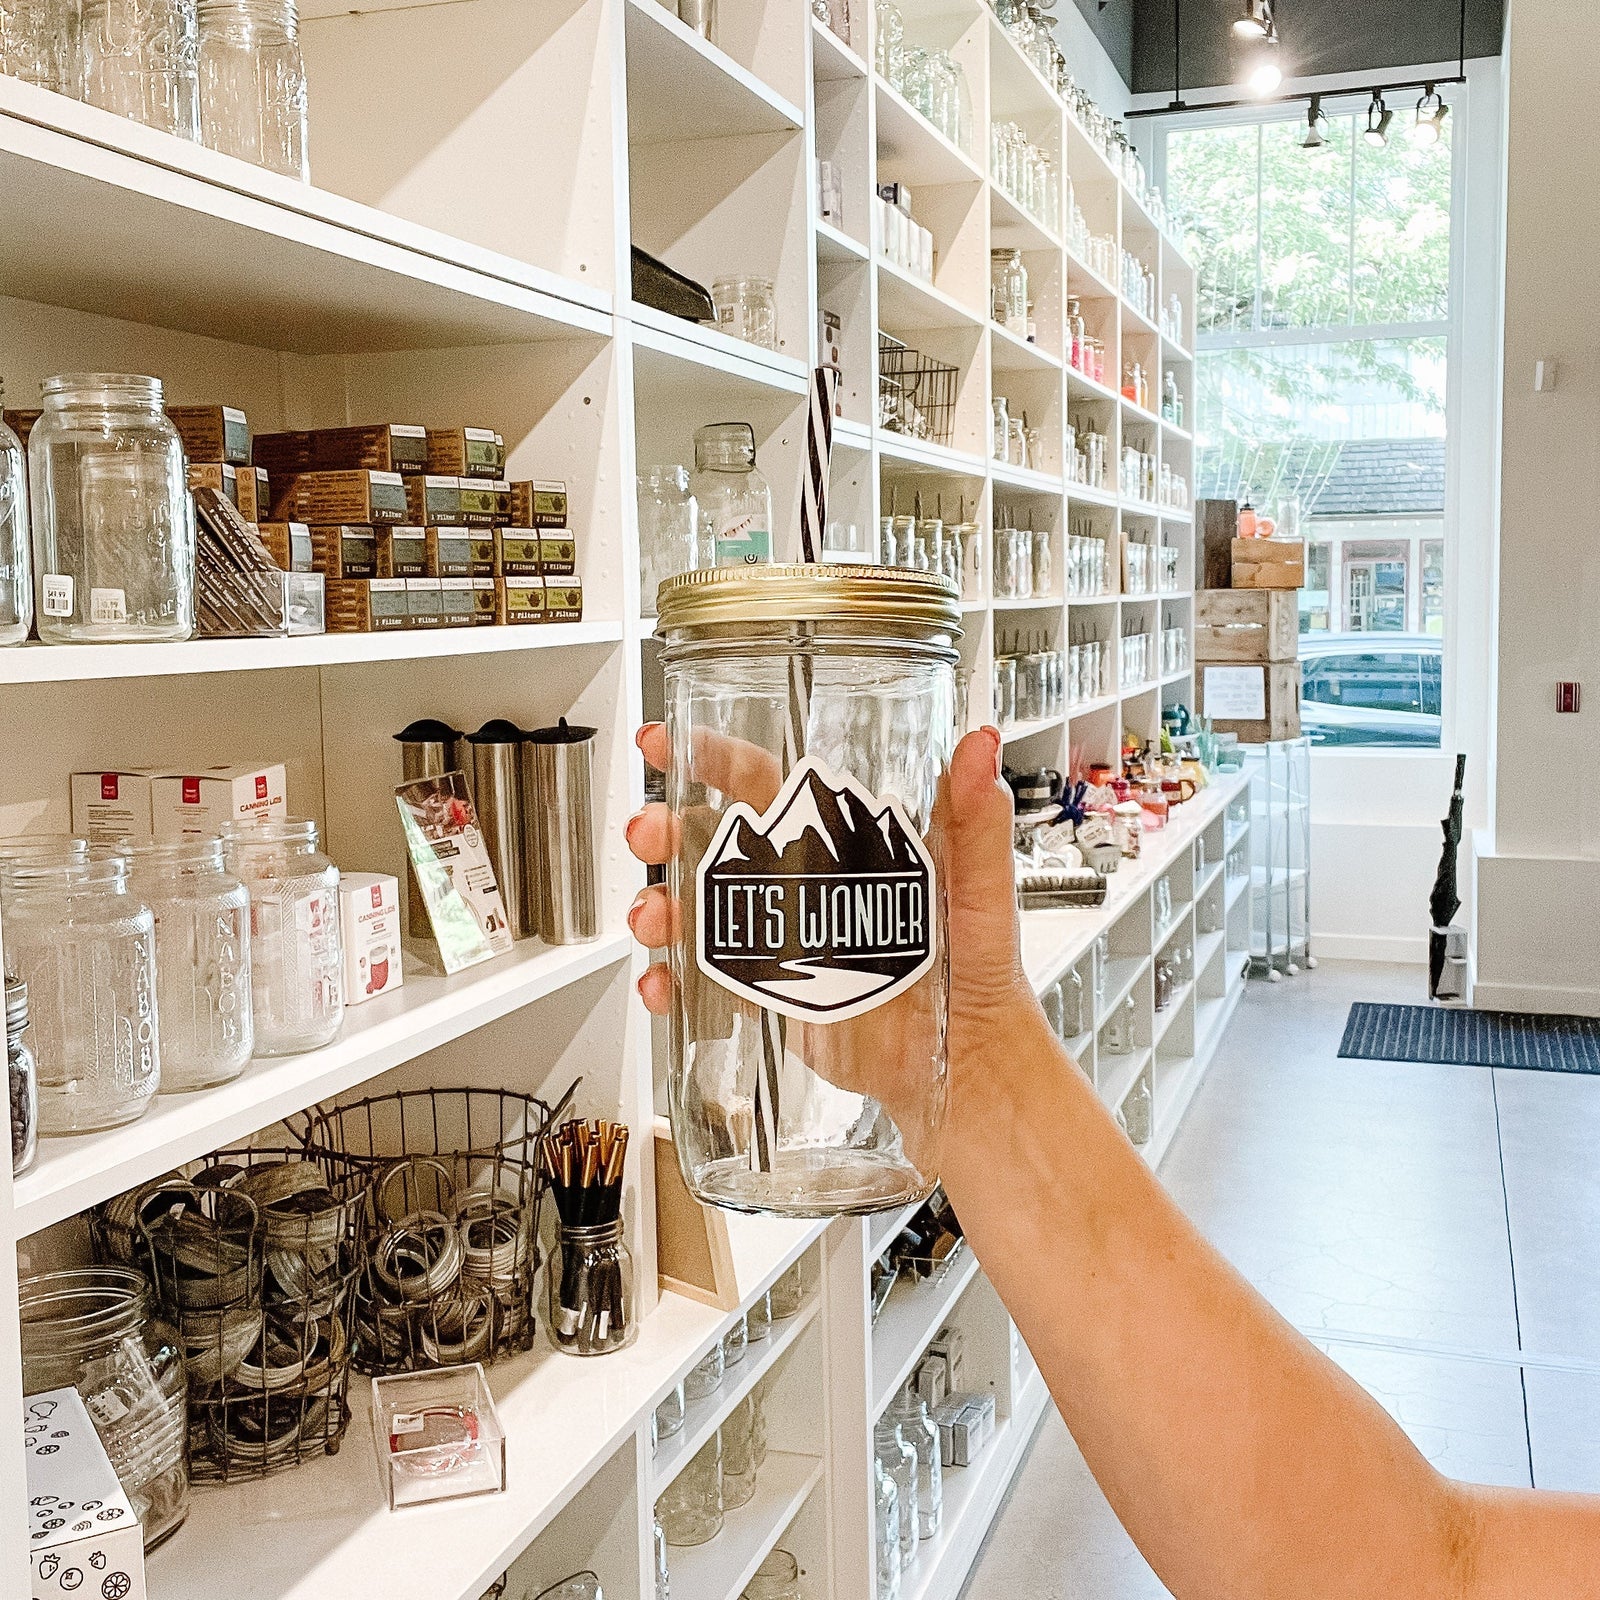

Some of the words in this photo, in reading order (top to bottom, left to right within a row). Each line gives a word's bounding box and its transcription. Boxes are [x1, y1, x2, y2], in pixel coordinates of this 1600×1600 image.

[382, 510, 402, 518] Filter
[469, 514, 492, 522] Filters
[512, 563, 535, 571] Filters
[239, 799, 269, 812] CANNING
[270, 795, 282, 805] LIDS
[357, 909, 384, 923] CANNING
[713, 883, 784, 949] LET'S
[799, 881, 924, 949] WANDER
[216, 910, 236, 1041] NABOB
[134, 937, 154, 1074] NABOB
